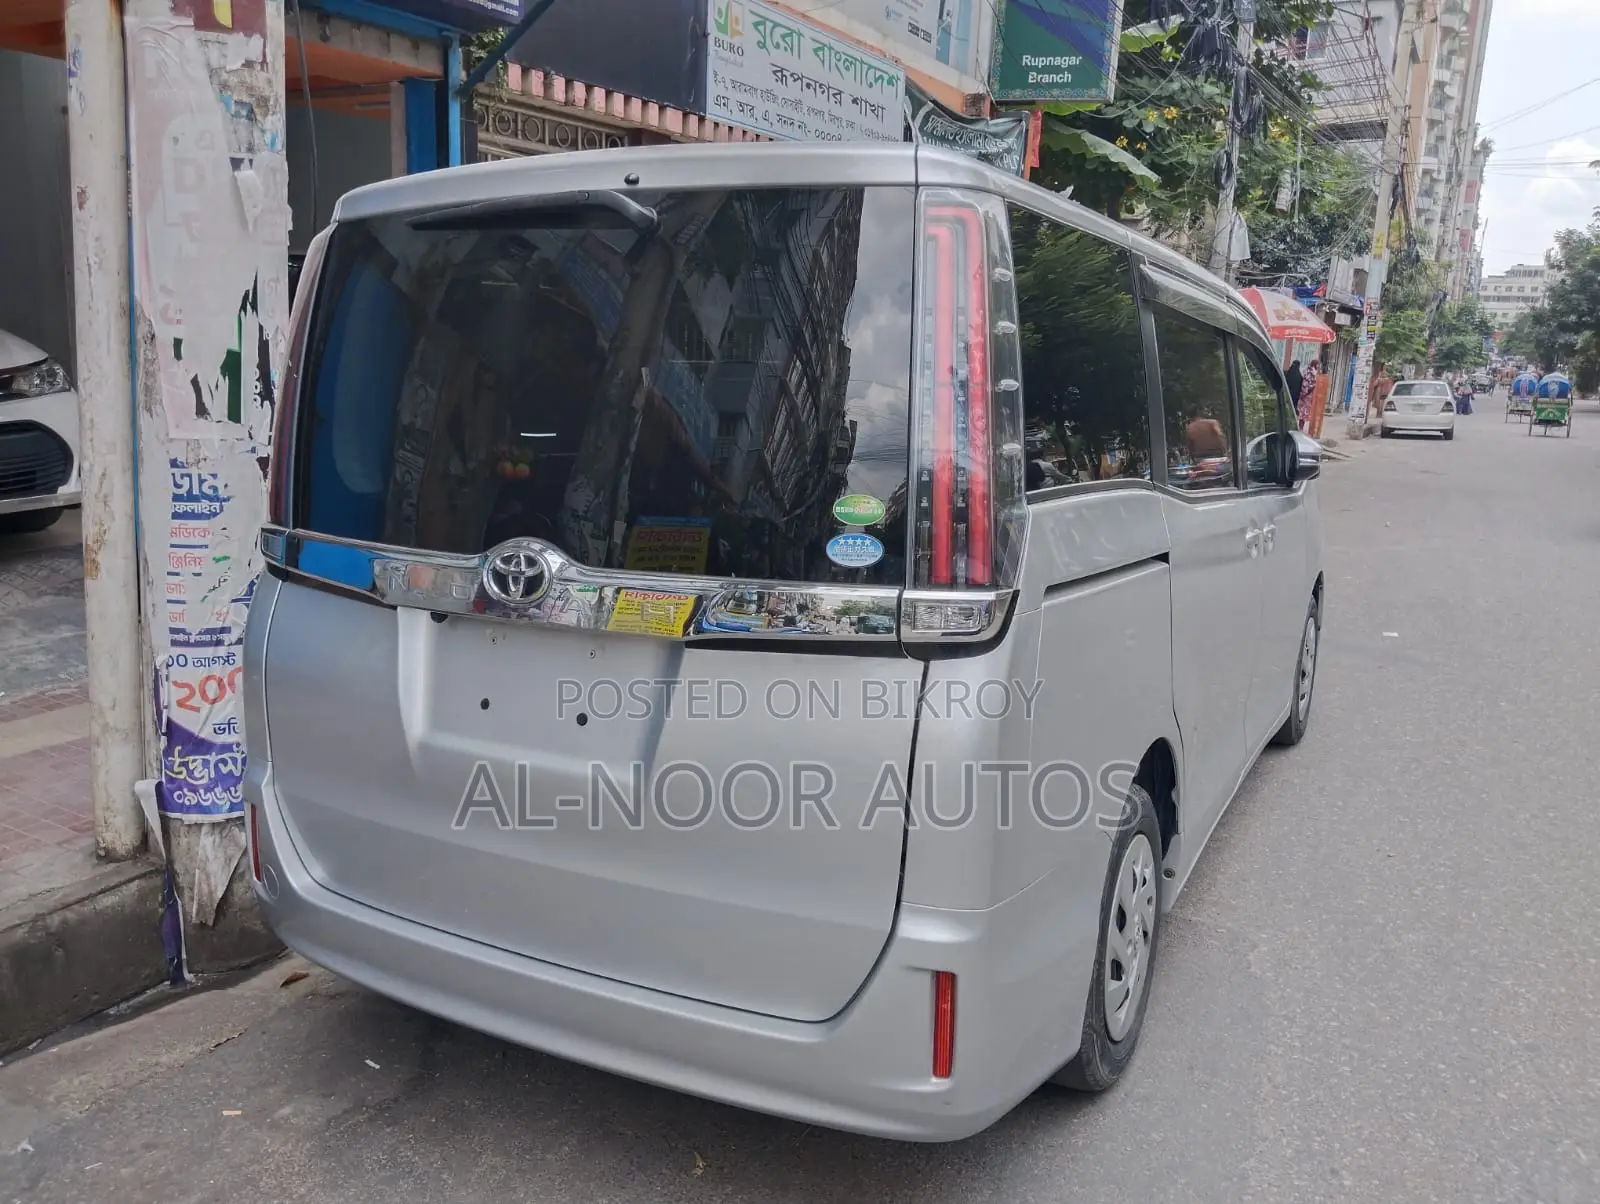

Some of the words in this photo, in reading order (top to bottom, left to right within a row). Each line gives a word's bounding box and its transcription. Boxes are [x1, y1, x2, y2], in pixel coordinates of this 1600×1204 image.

[714, 36, 744, 57] BURO
[749, 9, 804, 59] বুরো
[810, 37, 901, 98] বাংলাদেশ
[1022, 55, 1082, 68] Rupnagar
[1028, 71, 1072, 83] Branch
[770, 63, 845, 106] রূপনগর
[849, 93, 886, 124] শাখা
[192, 652, 236, 668] আগস্ট
